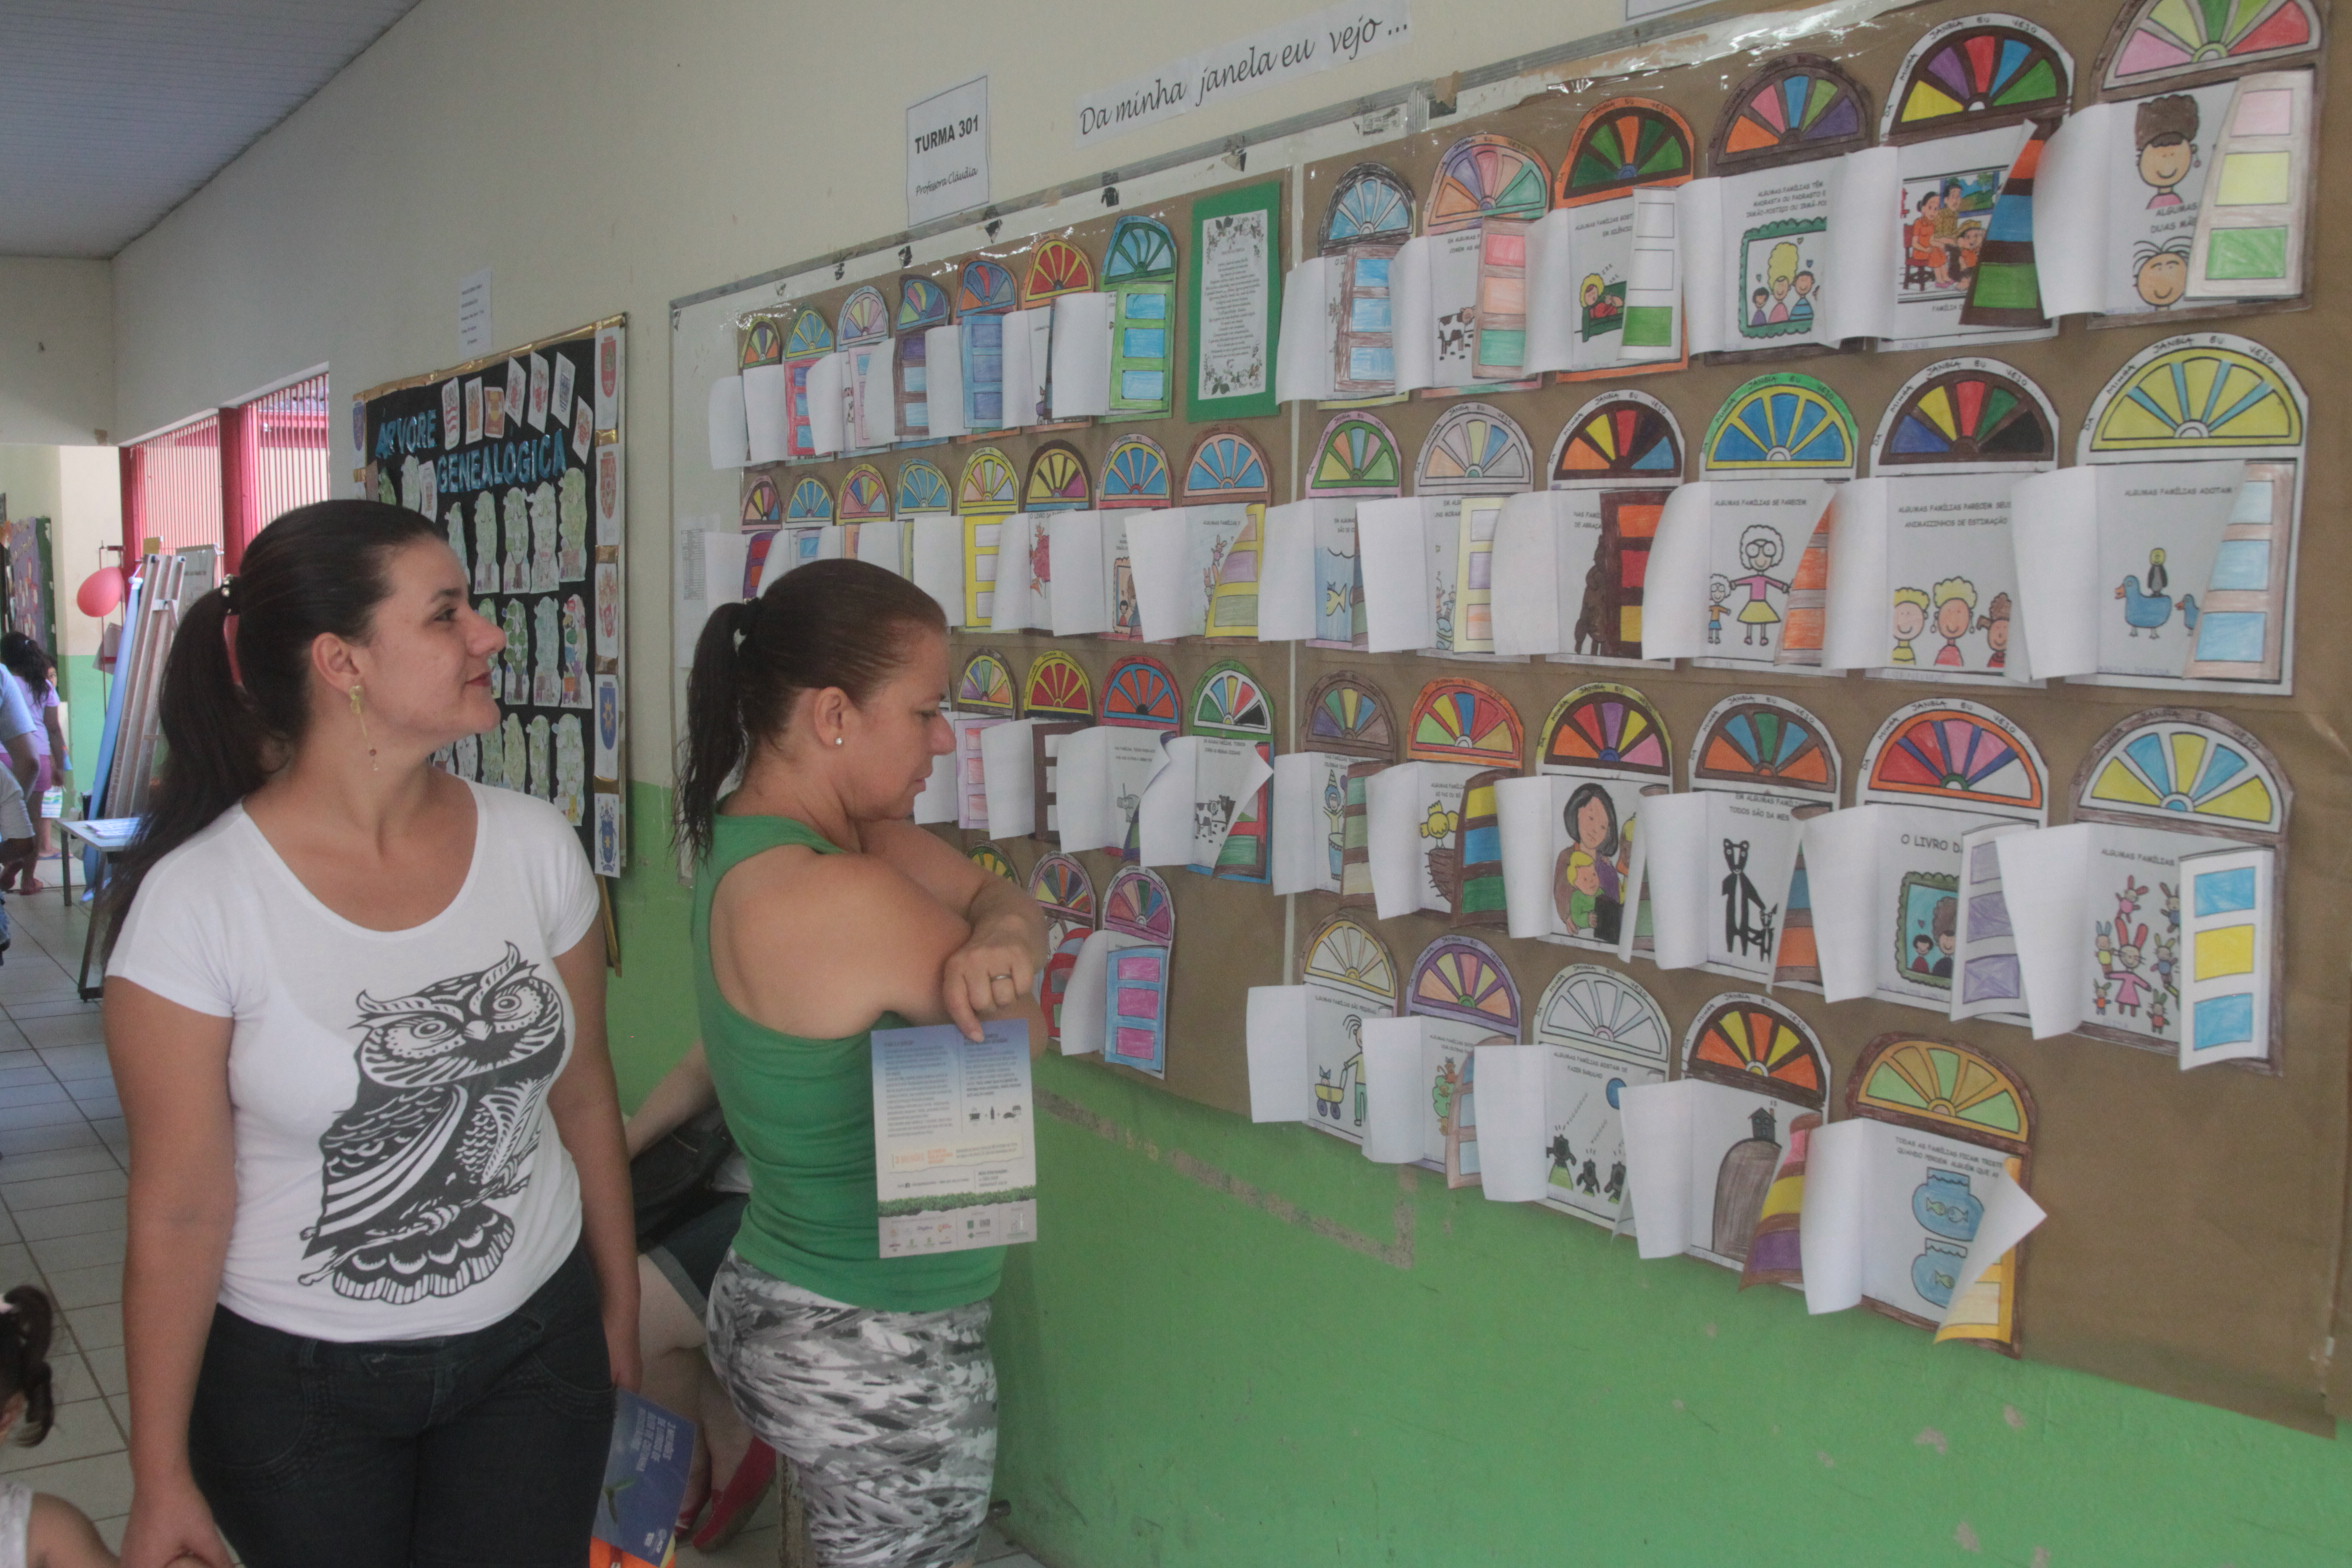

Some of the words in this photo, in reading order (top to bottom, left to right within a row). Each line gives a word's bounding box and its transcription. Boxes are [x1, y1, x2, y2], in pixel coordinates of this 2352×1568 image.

[1080, 105, 1112, 136] Da
[1113, 77, 1188, 123] minha
[1196, 46, 1277, 107] janela
[1280, 40, 1315, 66] eu
[1328, 14, 1384, 61] vejo
[915, 124, 955, 154] TURMA
[959, 114, 978, 138] 301
[916, 179, 947, 196] Professora
[2155, 202, 2198, 217] ALGUMAS
[2150, 222, 2176, 234] DUAS
[1901, 833, 1910, 845] O
[1914, 835, 1949, 852] LIVRO
